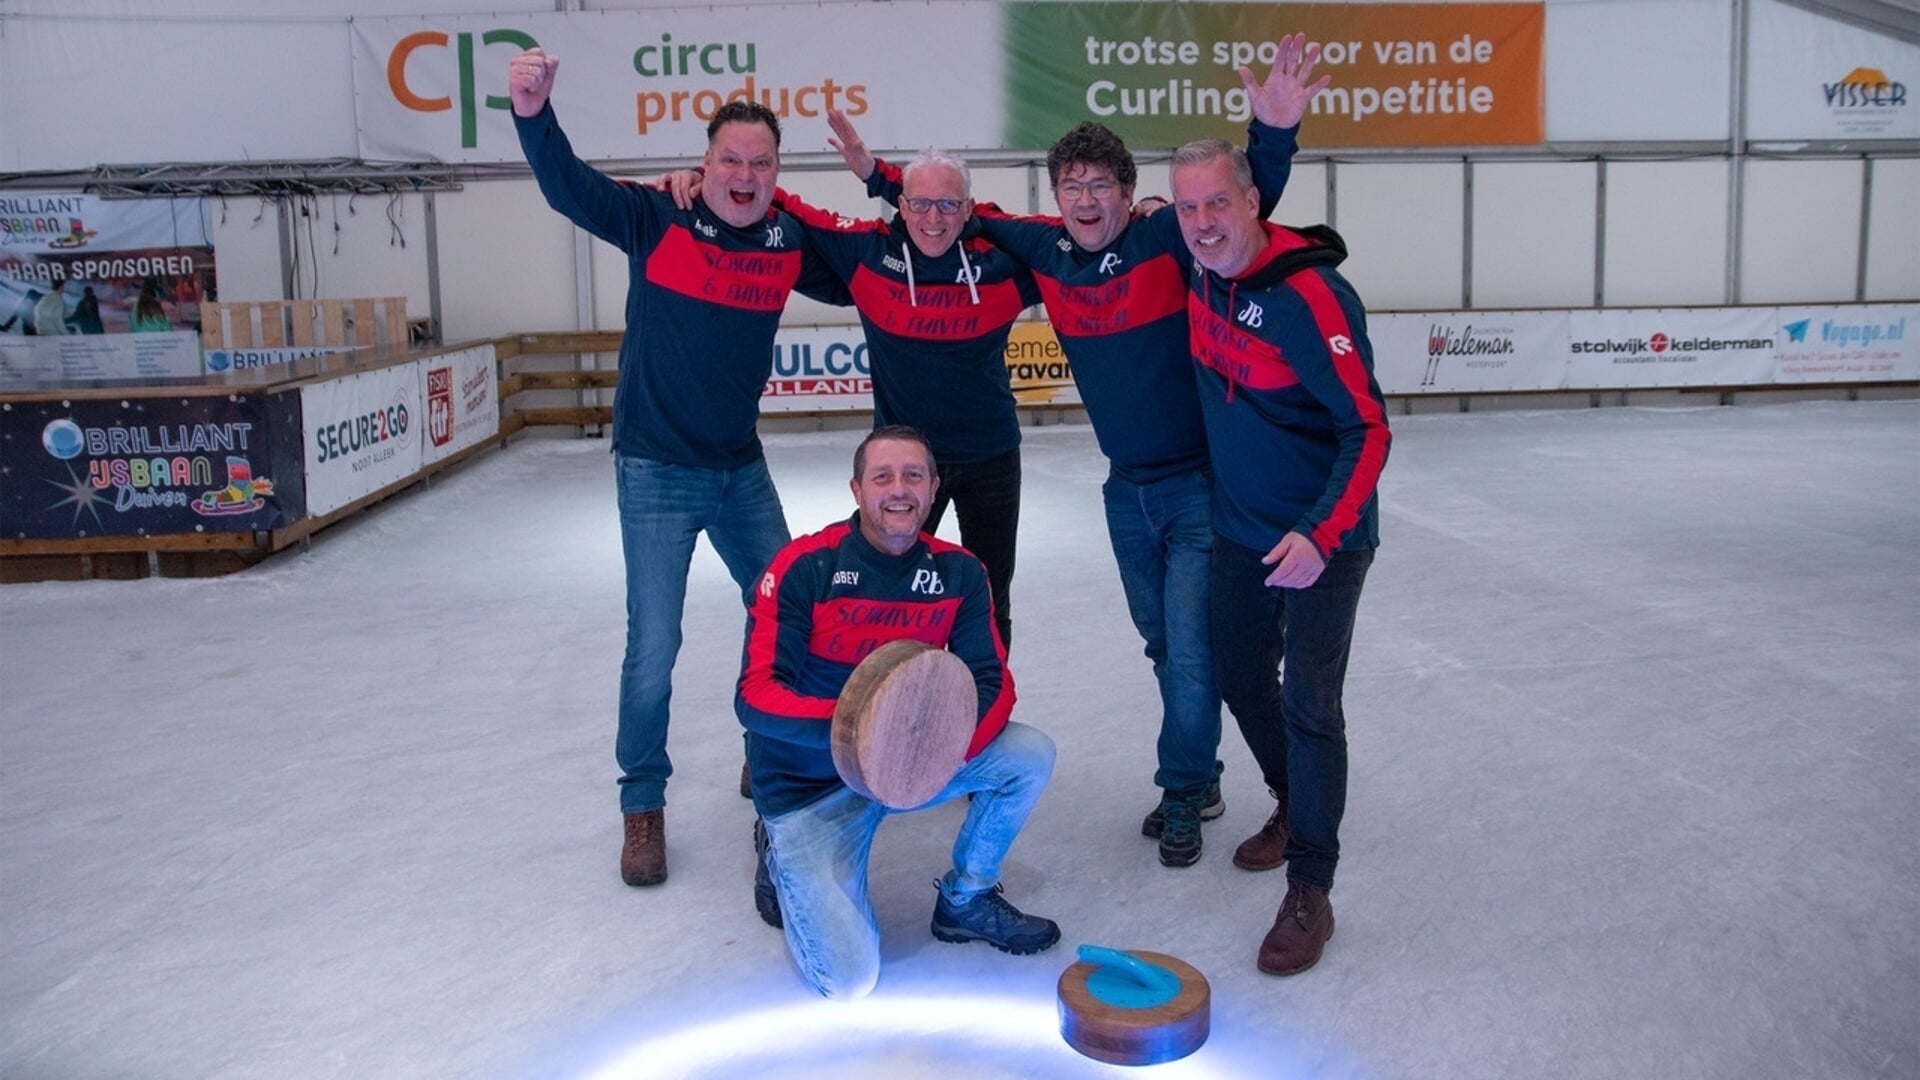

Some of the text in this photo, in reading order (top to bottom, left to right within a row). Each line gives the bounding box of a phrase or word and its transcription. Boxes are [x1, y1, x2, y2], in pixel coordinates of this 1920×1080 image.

[632, 33, 756, 77] circu
[1084, 34, 1493, 70] trotse sposor van de
[637, 77, 868, 134] products
[1822, 81, 1907, 107] VISSER
[7, 255, 194, 281] HAAR SPONSOREN
[1428, 323, 1515, 357] Wieleman
[1571, 337, 1774, 355] stolwijk kelderman
[85, 422, 253, 456] BRILLIANT
[317, 403, 409, 464] SECURE2GO
[115, 484, 188, 512] Duiven
[832, 571, 860, 586] OBEY
